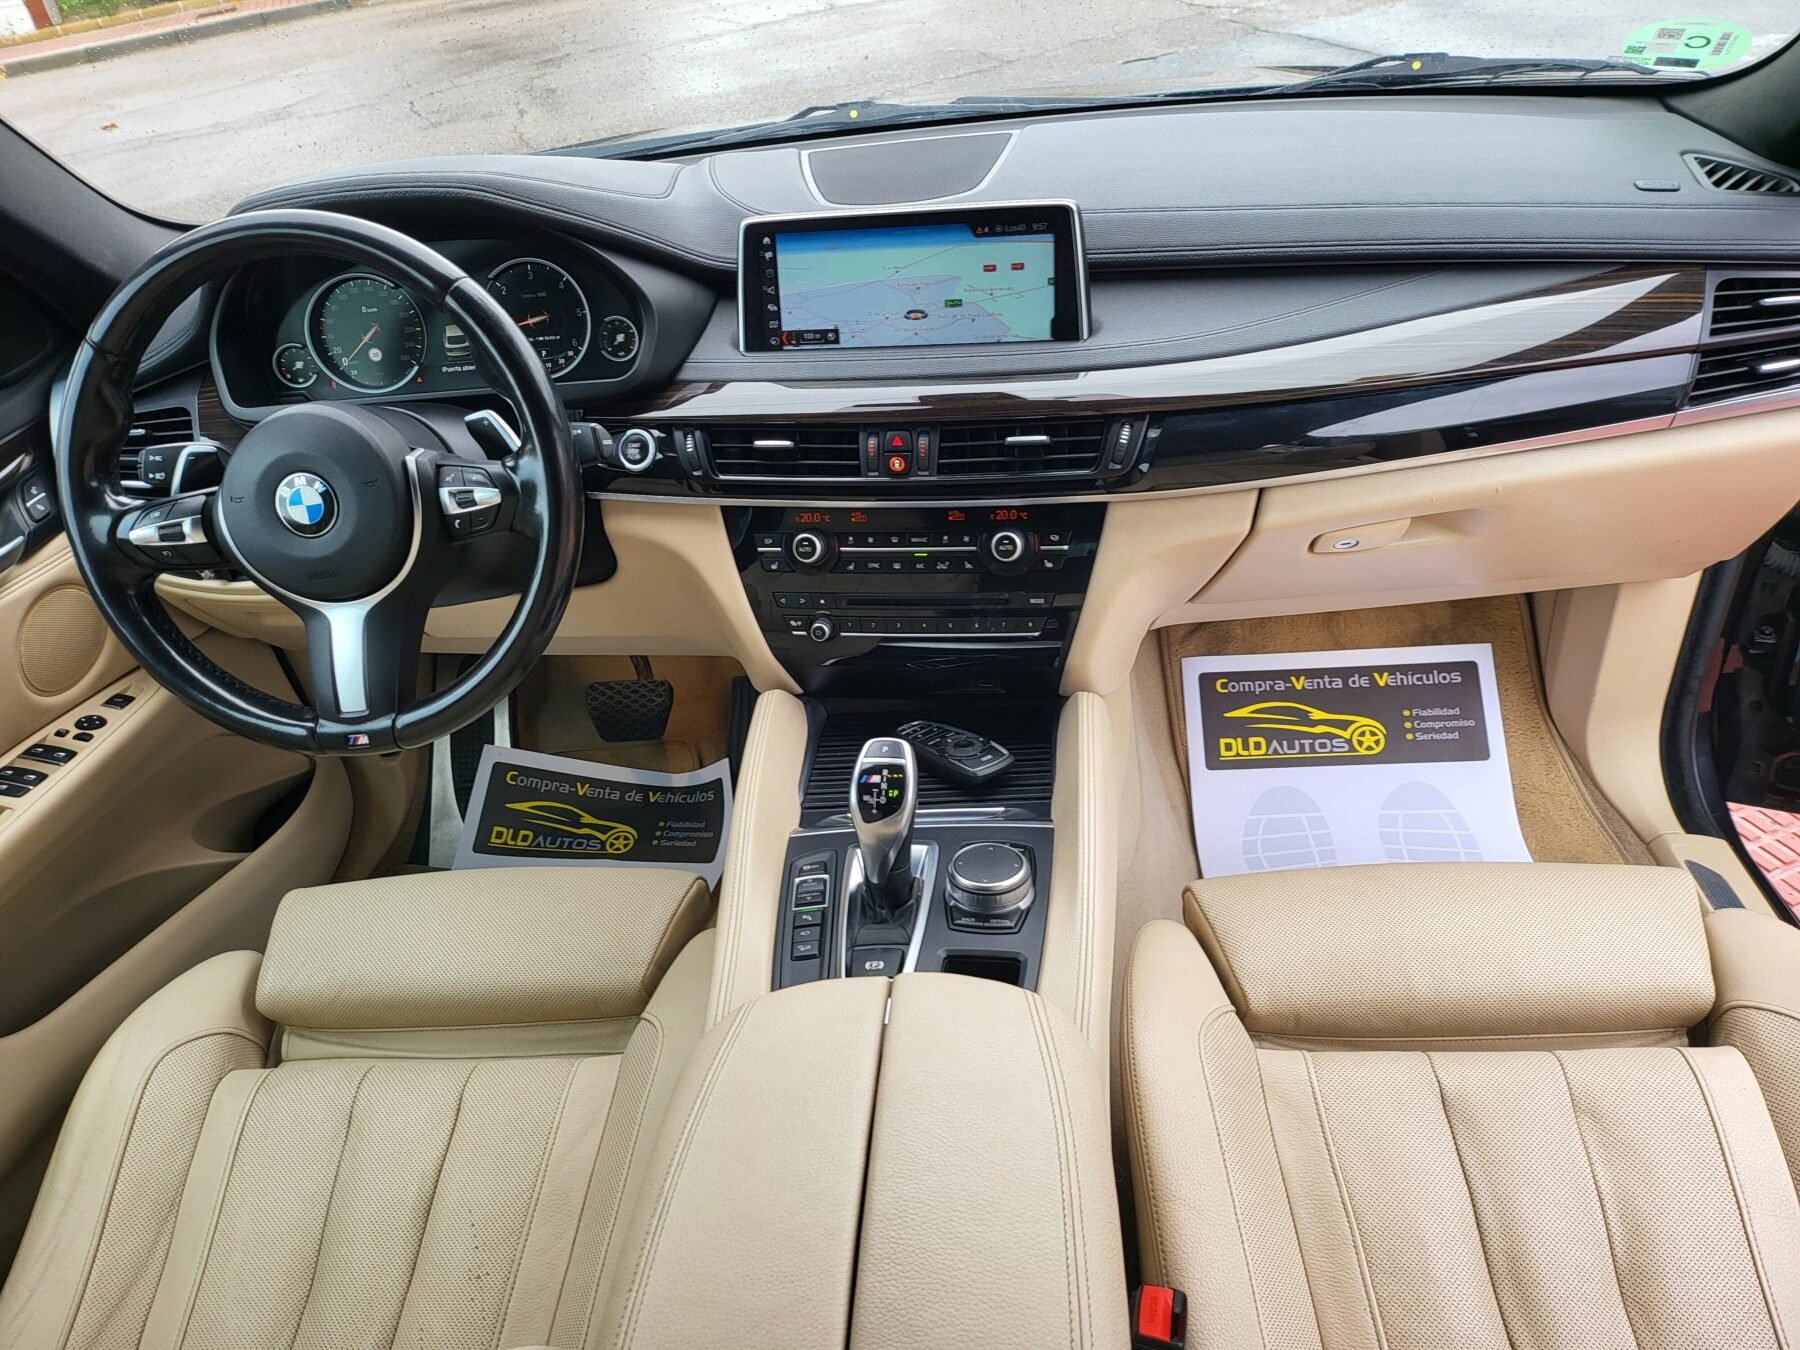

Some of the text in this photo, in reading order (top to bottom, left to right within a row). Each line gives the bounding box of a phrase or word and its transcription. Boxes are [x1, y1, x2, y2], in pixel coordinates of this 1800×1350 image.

[1032, 222, 1048, 231] 9:57
[528, 272, 534, 280] 3
[501, 286, 507, 294] 2
[558, 281, 565, 290] 4
[576, 308, 582, 316] 5
[572, 338, 578, 347] 6
[332, 346, 342, 354] 20
[342, 358, 348, 366] 0
[280, 476, 327, 498] BMW
[800, 512, 820, 522] 20.0
[996, 510, 1017, 520] 20.0
[1216, 670, 1462, 694] Compra-Venta de Vehículos
[1412, 706, 1460, 716] Fiabilidad
[1414, 718, 1476, 730] Compromiso
[1416, 731, 1460, 740] Seriedad
[506, 771, 715, 803] Compra-Venta de Vehículos
[894, 790, 899, 798] P
[663, 830, 714, 838] Compromiso
